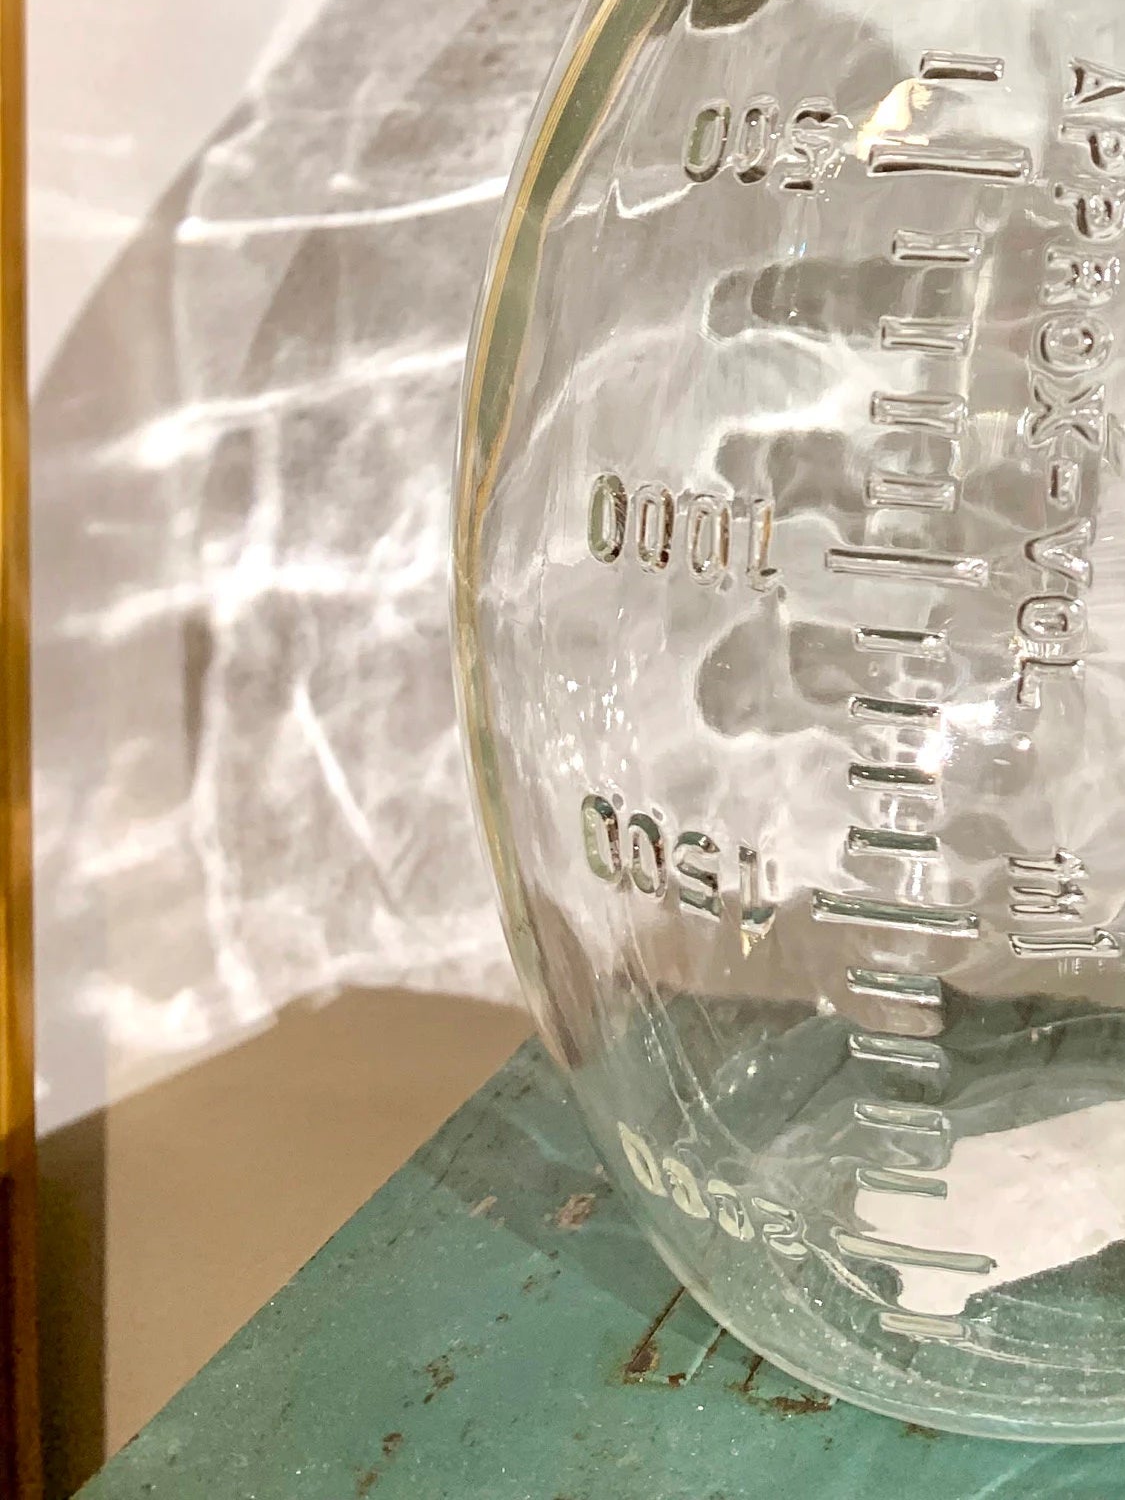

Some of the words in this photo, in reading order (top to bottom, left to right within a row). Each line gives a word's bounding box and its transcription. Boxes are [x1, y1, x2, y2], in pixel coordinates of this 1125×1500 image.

[682, 96, 841, 194] 500
[587, 472, 784, 591] 1000
[581, 794, 777, 936] 1500
